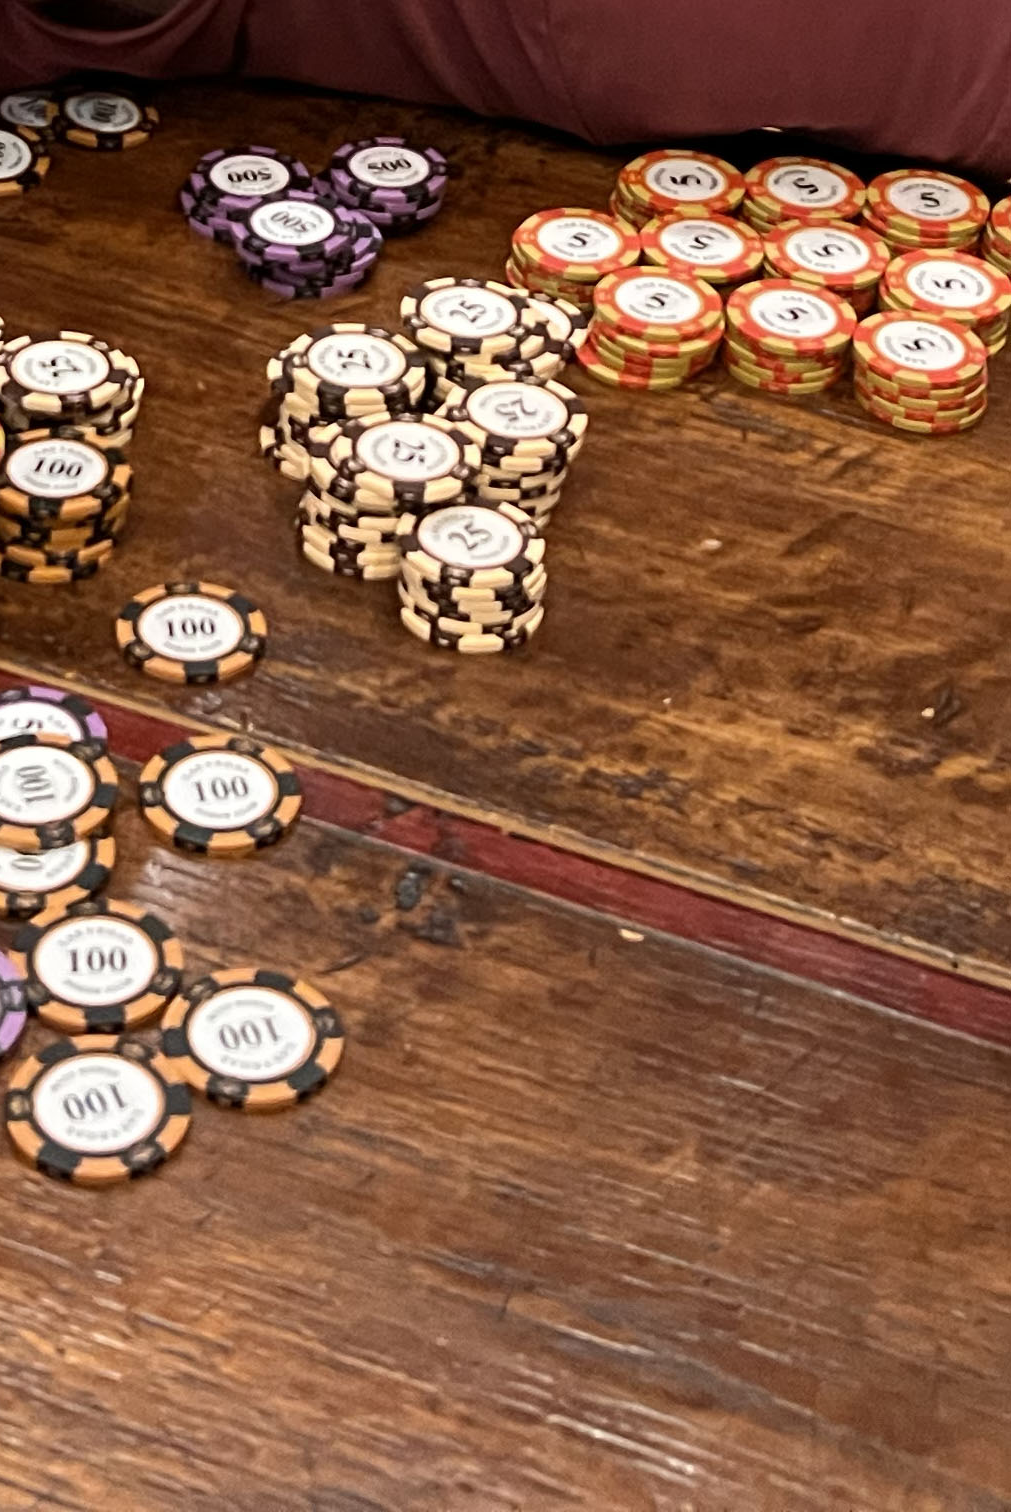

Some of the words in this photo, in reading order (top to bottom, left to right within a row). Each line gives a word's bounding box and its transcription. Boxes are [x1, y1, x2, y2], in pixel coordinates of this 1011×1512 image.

[228, 167, 272, 184] 500
[368, 157, 412, 174] 500
[670, 173, 701, 186] 5
[793, 177, 819, 195] 5
[920, 192, 940, 208] 5
[270, 210, 316, 234] 500
[568, 232, 590, 248] 5
[689, 234, 714, 250] 5
[813, 243, 844, 257] 5
[932, 278, 966, 290] 5
[449, 300, 487, 323] 25
[645, 292, 669, 309] 5
[777, 306, 809, 322] 5
[903, 337, 936, 352] 5
[337, 348, 372, 370] 25
[494, 397, 538, 423] 25
[392, 438, 426, 464] 25
[33, 456, 83, 479] 100
[447, 522, 493, 551] 25
[167, 616, 216, 638] 100
[16, 765, 55, 803] 100
[194, 775, 249, 803] 100
[69, 946, 128, 973] 100
[219, 1015, 284, 1050] 100
[62, 1082, 127, 1121] 100
